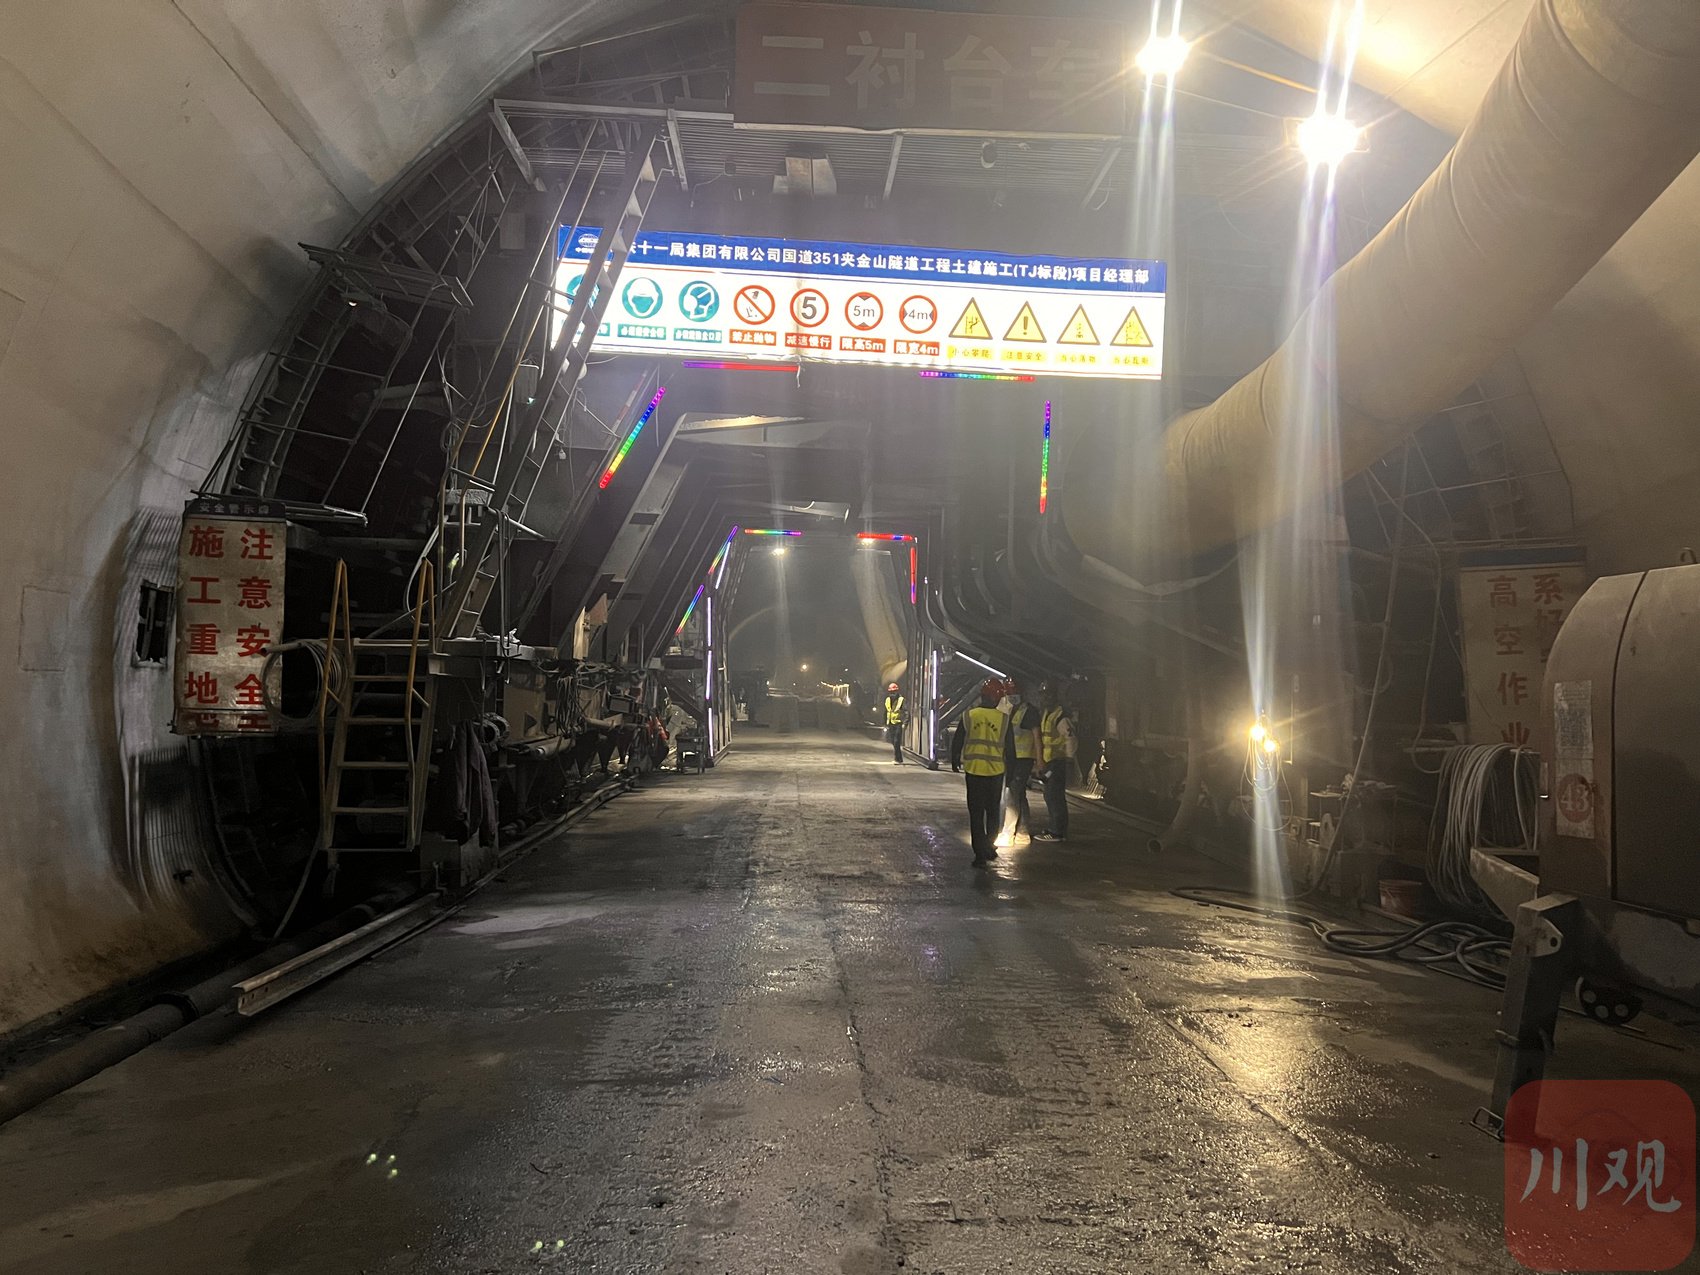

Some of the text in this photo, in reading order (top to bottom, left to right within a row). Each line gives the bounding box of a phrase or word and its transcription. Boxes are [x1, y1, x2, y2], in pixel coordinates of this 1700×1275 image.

[753, 30, 1103, 114] 二衬台车
[801, 296, 817, 320] 5
[853, 305, 875, 318] 5m
[908, 309, 929, 320] 4m
[786, 335, 831, 348] 减速慢行
[841, 337, 883, 351] 限高5m
[896, 341, 938, 354] 限宽4m
[1006, 351, 1042, 361] 注意安全
[184, 525, 224, 705] 施工重地
[235, 527, 274, 706] 注意安全
[1488, 574, 1531, 749] 高空作业
